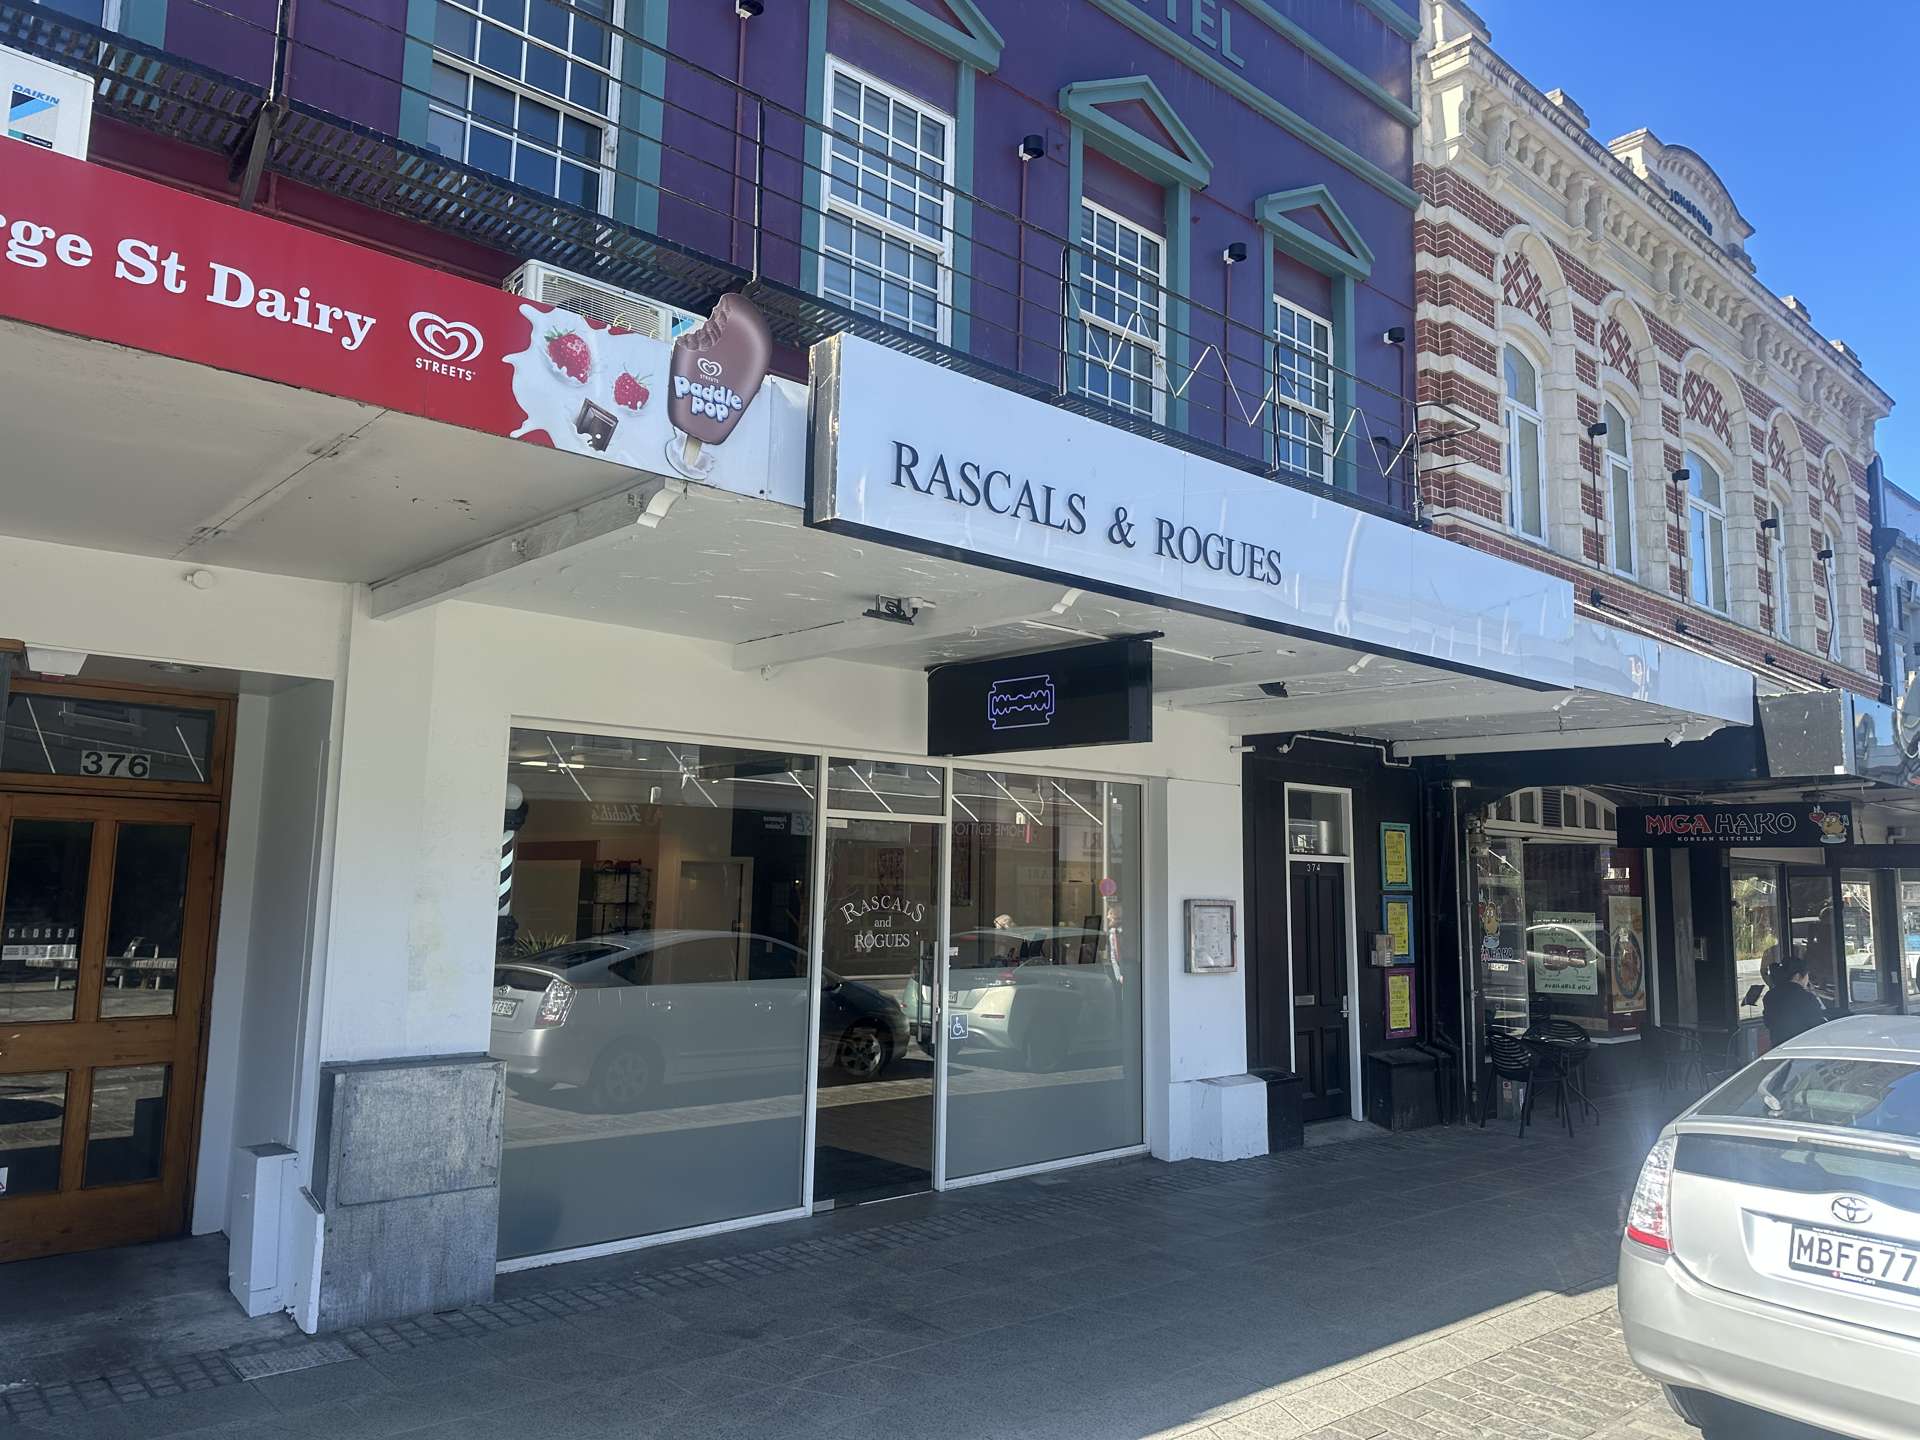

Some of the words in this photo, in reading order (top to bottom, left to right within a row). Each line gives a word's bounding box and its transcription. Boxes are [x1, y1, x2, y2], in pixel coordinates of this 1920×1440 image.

[13, 84, 60, 105] DAIKIN
[115, 238, 187, 294] St
[207, 263, 376, 351] Dairy
[415, 357, 472, 381] STREETS
[891, 440, 1087, 535] RASCALS
[1107, 506, 1136, 548] &
[1154, 518, 1282, 586] ROGUES
[83, 751, 149, 777] 376
[1646, 814, 1711, 835] MIGA
[1715, 812, 1797, 835] HAKO
[1306, 863, 1320, 872] 374
[840, 896, 925, 924] RASCALS
[874, 916, 892, 927] and
[8, 928, 75, 938] CLOSED
[854, 933, 910, 948] ROGUES
[1797, 1234, 1917, 1282] MBF677
